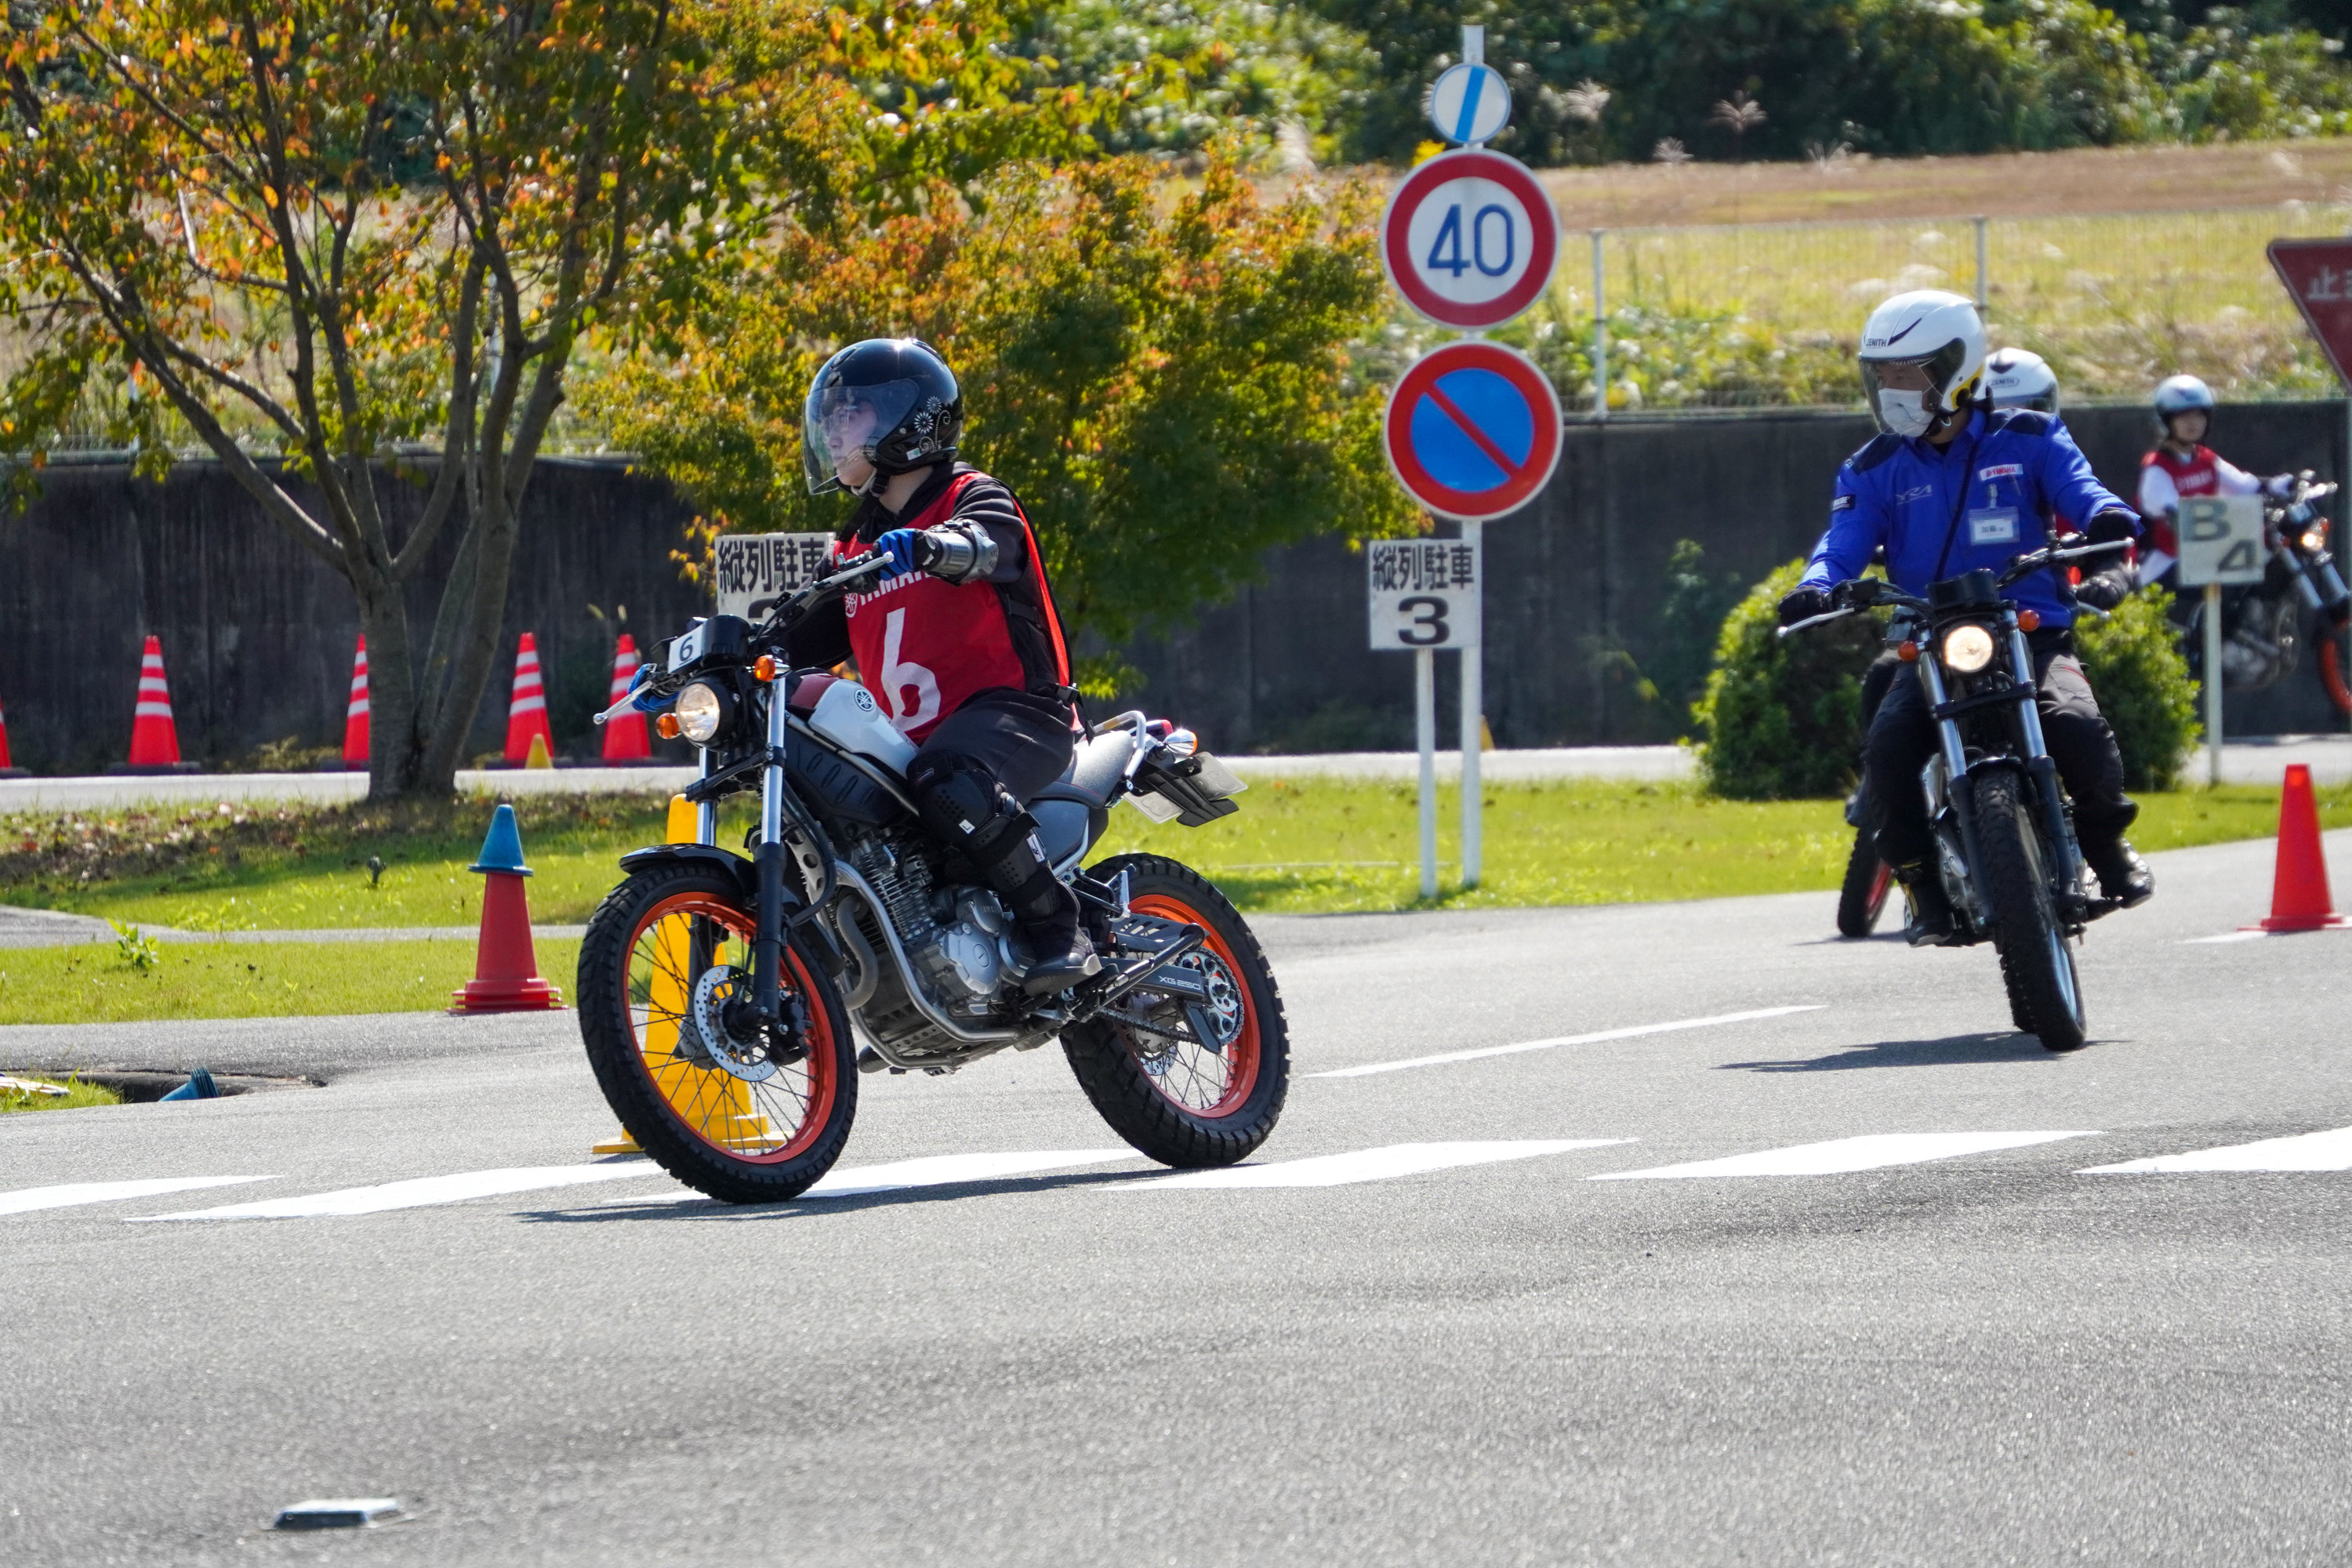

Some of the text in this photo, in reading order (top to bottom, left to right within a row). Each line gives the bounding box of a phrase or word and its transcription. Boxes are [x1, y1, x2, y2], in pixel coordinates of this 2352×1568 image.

[1428, 204, 1515, 278] 40
[2307, 267, 2352, 300] 止
[1866, 338, 1887, 347] ZENITH
[2182, 499, 2231, 542] B
[718, 537, 826, 593] 縦列駐車
[1373, 543, 1473, 591] 縦列駐車
[2217, 539, 2258, 573] 4
[1398, 596, 1449, 645] 3
[679, 635, 693, 662] 6
[880, 607, 941, 732] 6
